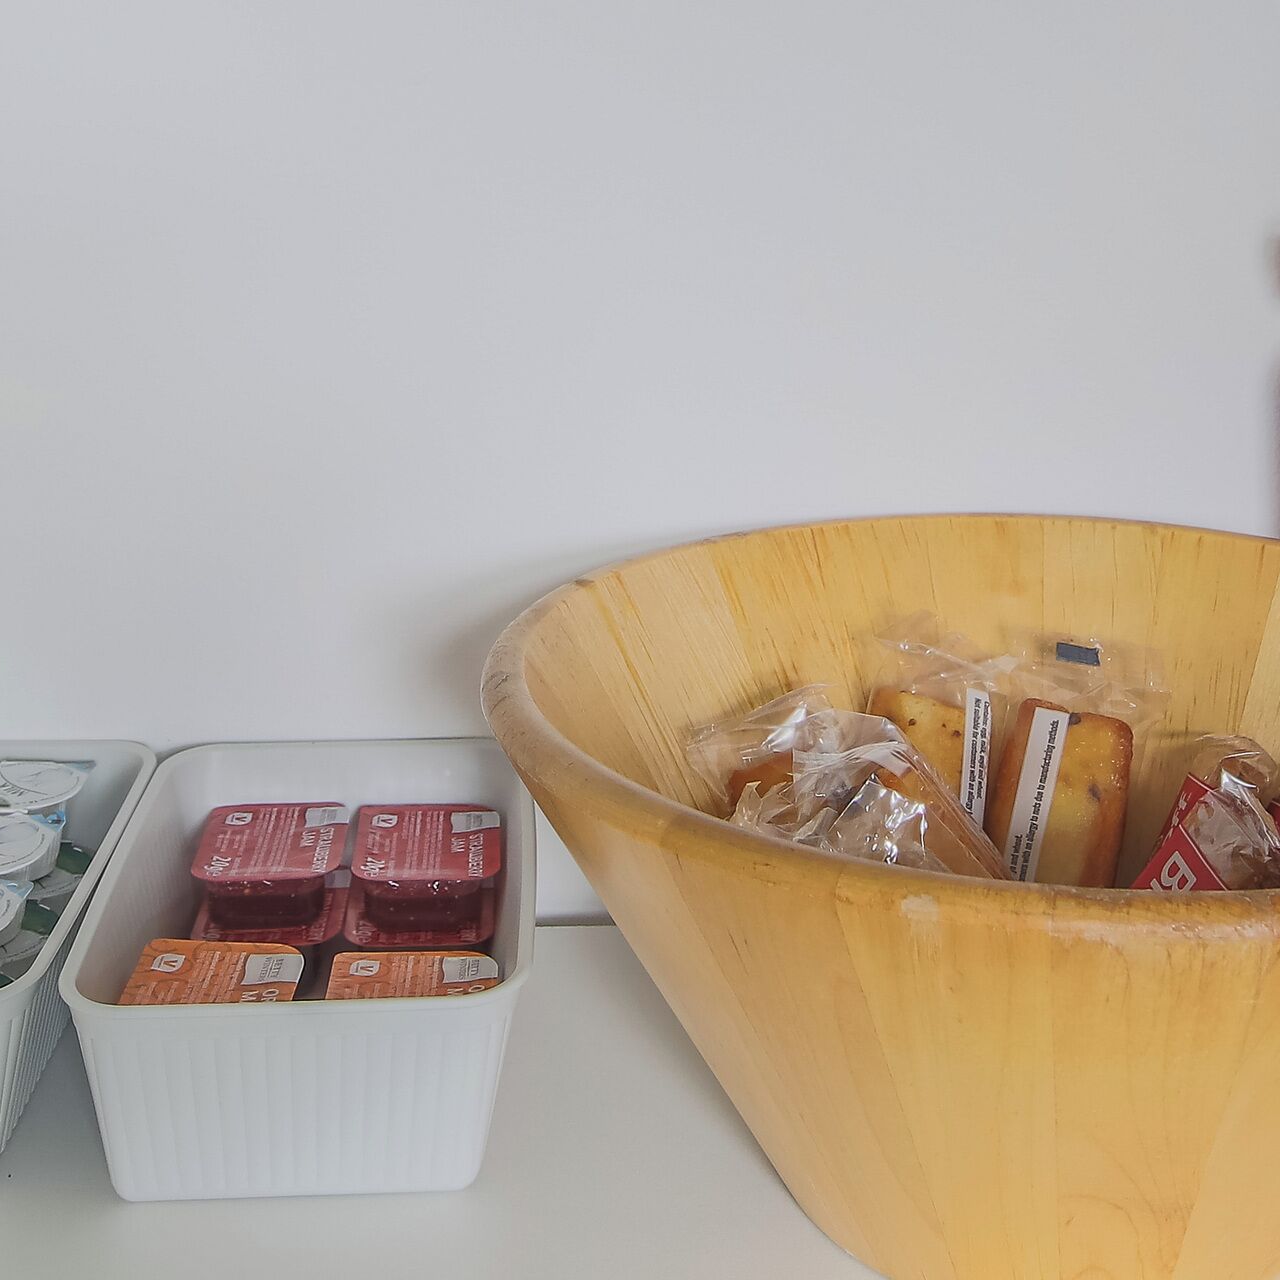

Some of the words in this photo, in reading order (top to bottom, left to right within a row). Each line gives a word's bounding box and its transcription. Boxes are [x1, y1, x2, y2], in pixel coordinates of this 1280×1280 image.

[974, 697, 982, 708] Not
[972, 708, 980, 730] suitable
[972, 730, 980, 739] for
[969, 739, 978, 769] customers
[1039, 744, 1056, 784] manufacturing
[968, 769, 976, 782] with
[299, 830, 316, 848] JAM
[451, 837, 465, 853] JAM
[310, 827, 334, 873] STRAWBERRY
[468, 833, 483, 878] STRAWBERRY
